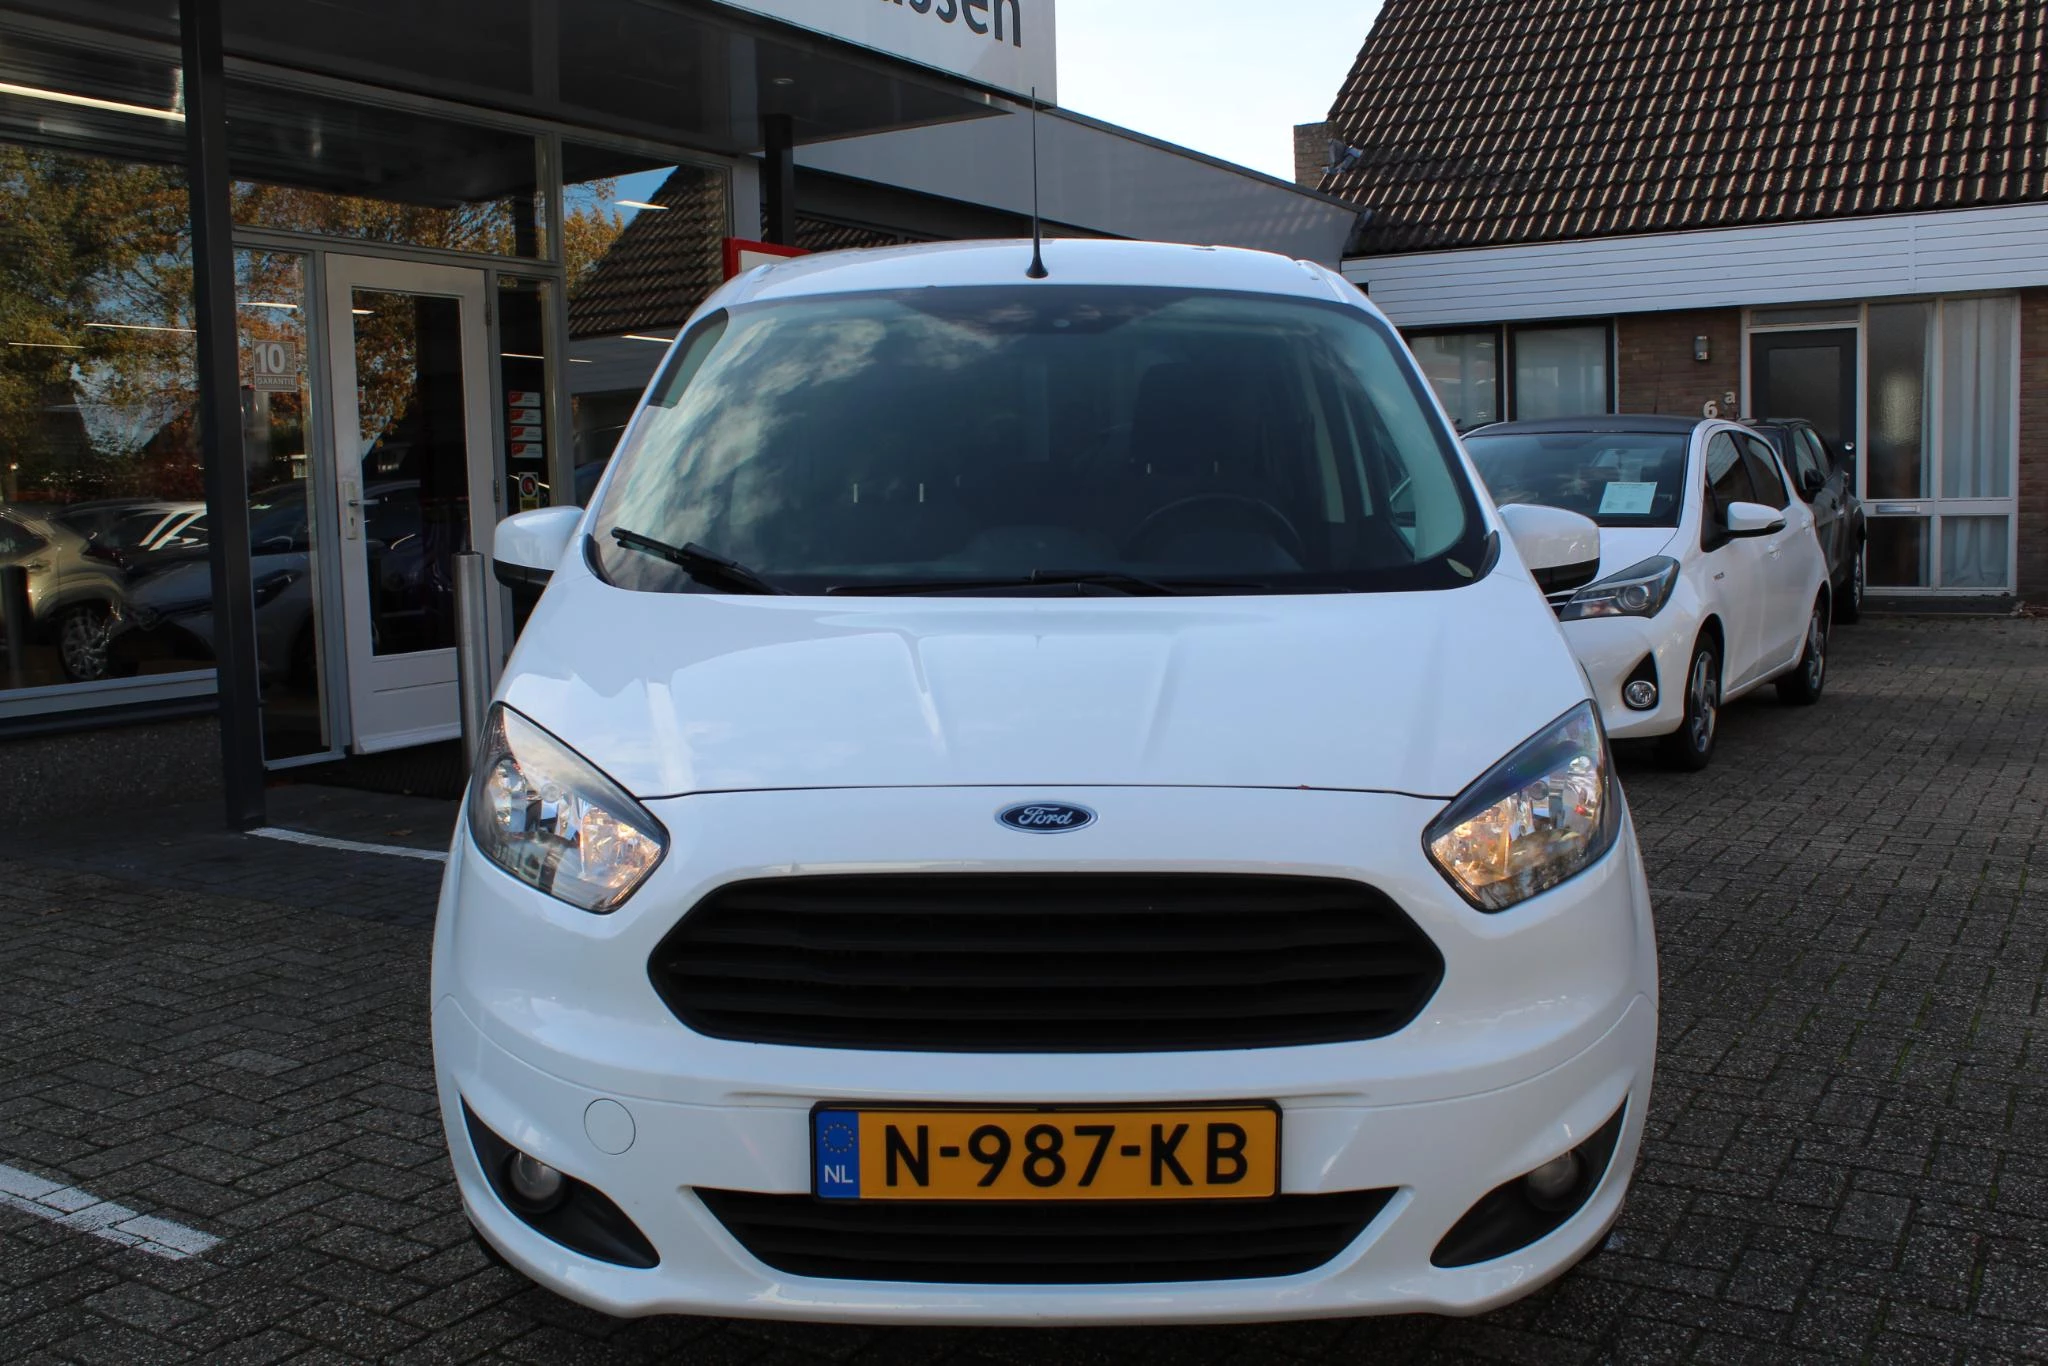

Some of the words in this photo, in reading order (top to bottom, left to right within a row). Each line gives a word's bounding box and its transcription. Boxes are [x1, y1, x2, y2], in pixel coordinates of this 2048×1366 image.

[255, 343, 286, 374] 10
[1018, 806, 1073, 825] Ford
[824, 1165, 853, 1184] NL
[885, 1122, 1248, 1188] N-987-KB
